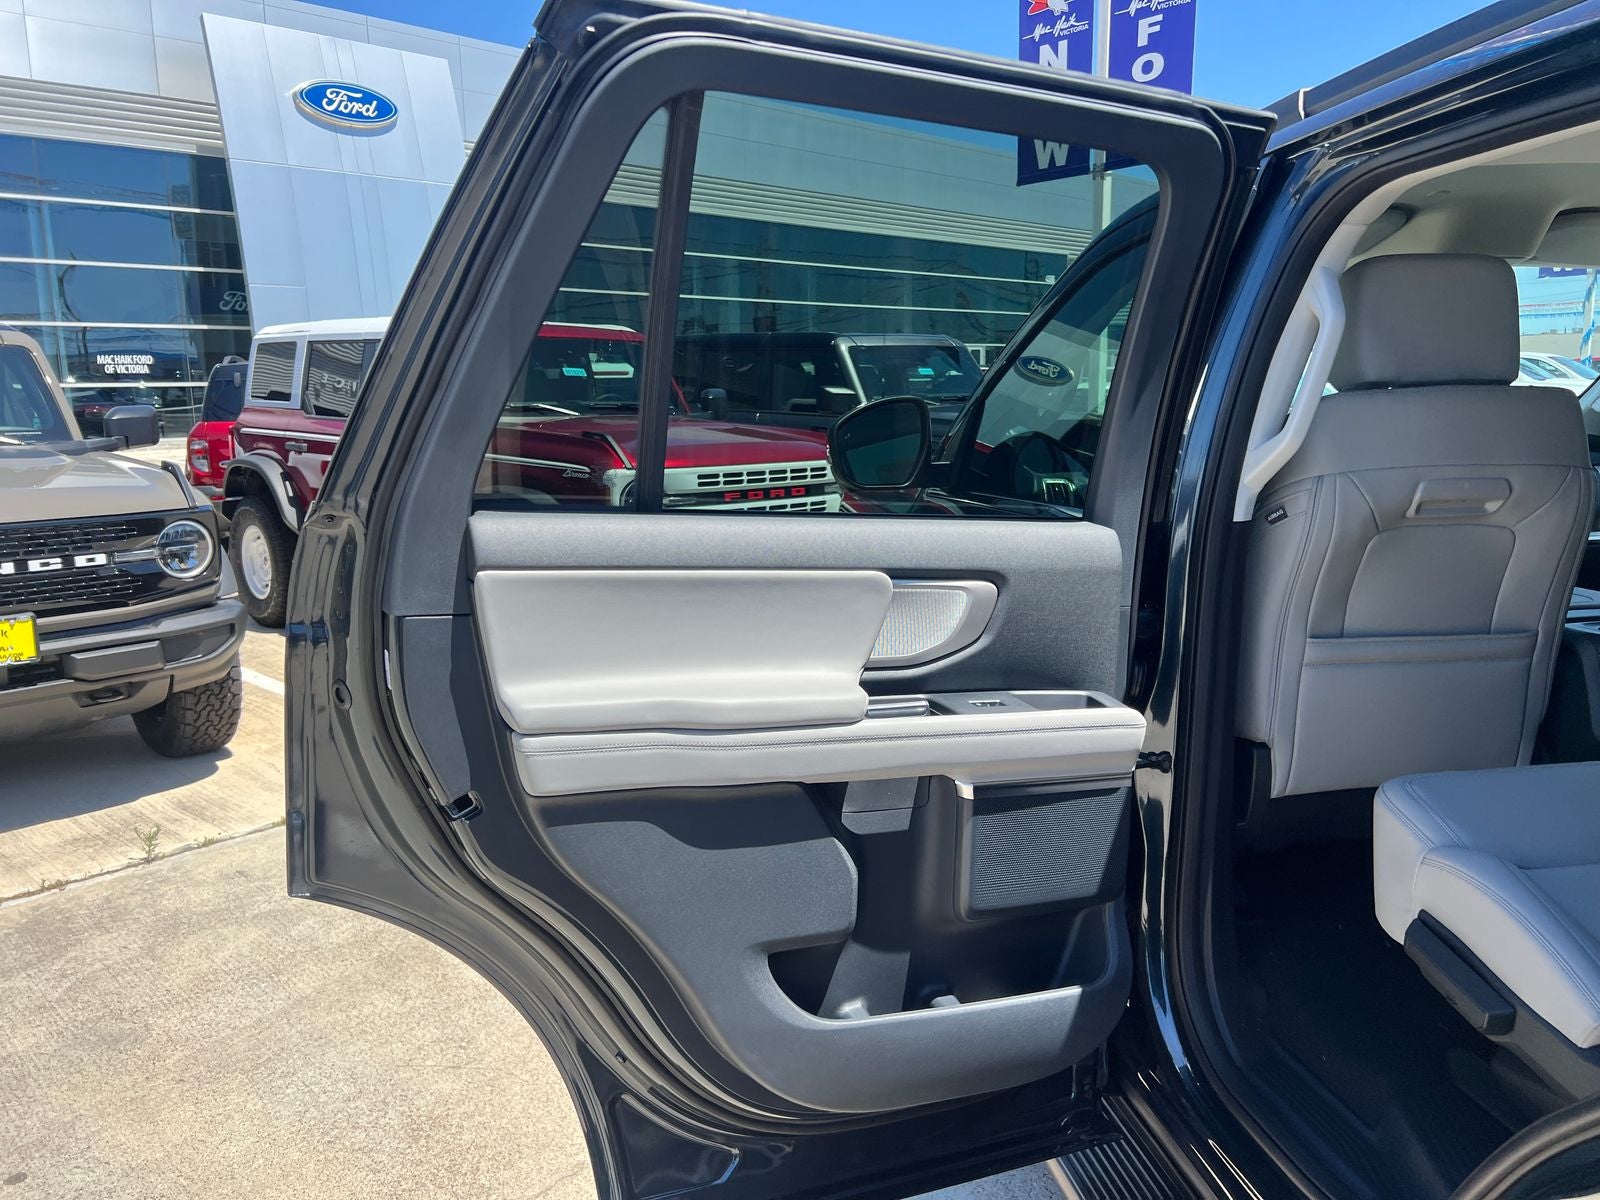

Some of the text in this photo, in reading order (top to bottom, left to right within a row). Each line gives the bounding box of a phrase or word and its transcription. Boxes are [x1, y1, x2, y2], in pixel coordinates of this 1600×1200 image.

[1060, 24, 1089, 37] VICTORIA
[322, 88, 379, 118] Ford
[96, 354, 154, 365] MAC HAIK FORD
[104, 364, 150, 374] OF VICTORIA
[723, 486, 806, 502] FORD
